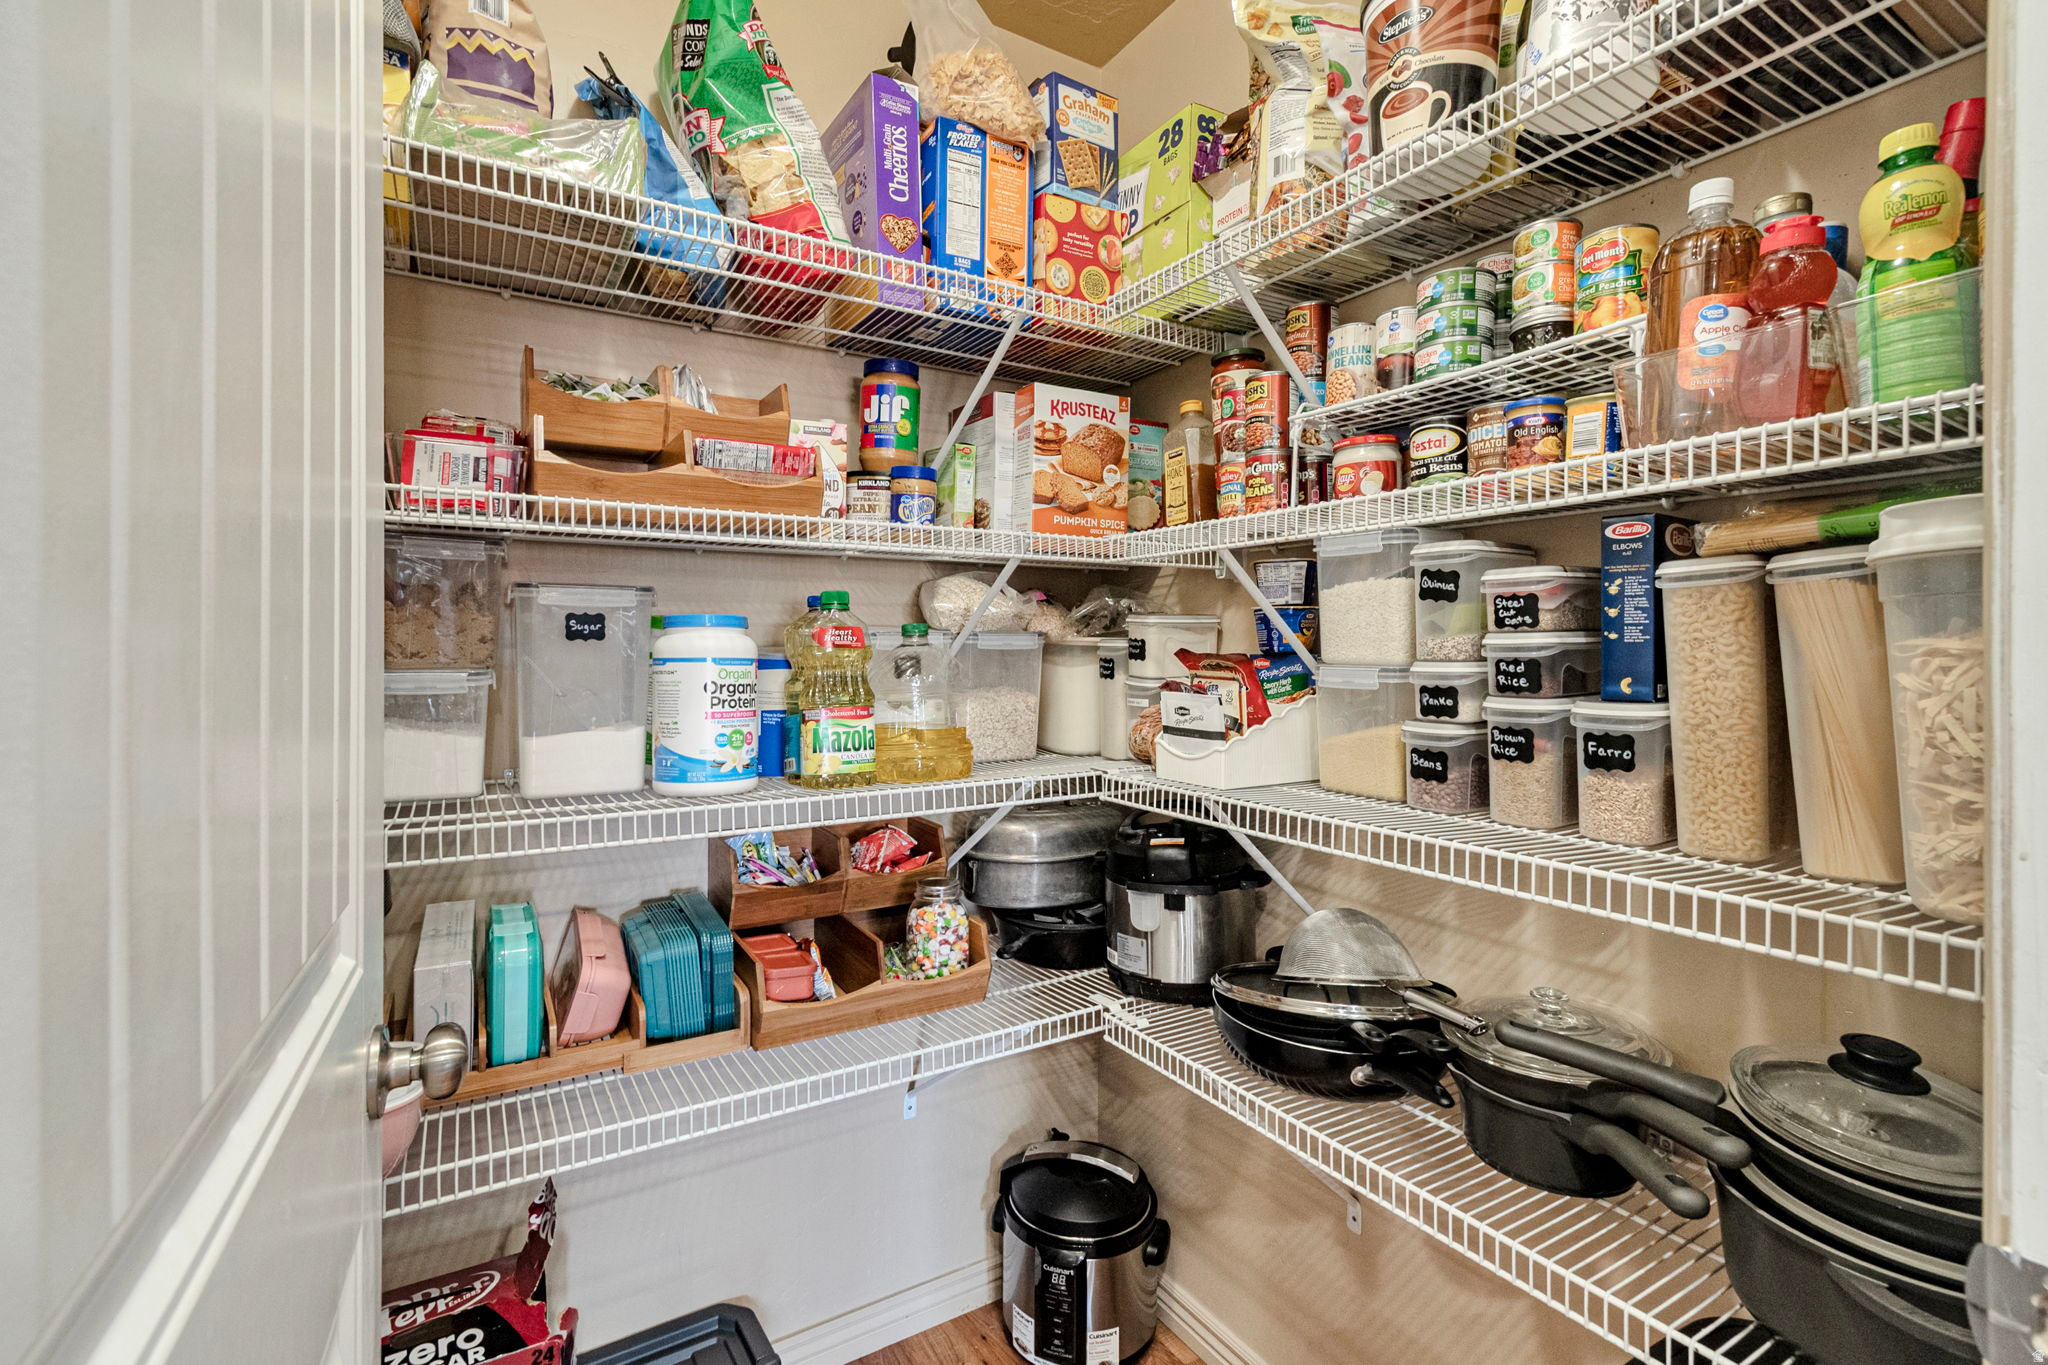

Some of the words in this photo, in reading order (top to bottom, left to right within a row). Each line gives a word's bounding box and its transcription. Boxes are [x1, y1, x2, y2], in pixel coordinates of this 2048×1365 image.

[1382, 10, 1428, 41] Stephen's
[1414, 55, 1445, 66] Chocolate
[1062, 95, 1110, 124] Graham
[882, 124, 892, 145] Grain
[946, 131, 982, 142] FROSTED
[1158, 118, 1184, 159] 28
[948, 138, 978, 149] FLAKES
[883, 148, 892, 170] Multi
[888, 126, 910, 202] Cheerios
[1163, 150, 1178, 166] BAGS
[1216, 206, 1242, 228] PROTEIN
[1906, 212, 1922, 220] LEMON
[1488, 256, 1514, 268] Chicke
[1582, 254, 1594, 267] Del
[1595, 245, 1626, 261] Monte
[1598, 278, 1638, 292] Peaches
[1700, 325, 1730, 334] Apple
[1334, 355, 1372, 368] BEANS
[864, 394, 910, 424] Jif
[1050, 399, 1117, 426] KRUSTEAZ
[1468, 424, 1506, 442] DICE
[1514, 429, 1528, 438] Old
[1530, 425, 1559, 436] English
[1470, 439, 1507, 452] TOMATOE
[450, 456, 460, 482] POPCORN
[460, 454, 470, 486] MICROWAVE
[1166, 466, 1186, 480] HONEY
[1252, 460, 1286, 474] Camp's
[1428, 462, 1463, 473] Beans
[1248, 476, 1266, 488] PORK
[902, 498, 934, 518] CRUNCHY
[1054, 514, 1098, 528] PUMPKIN
[1100, 519, 1126, 530] SPICE
[1614, 524, 1648, 536] Barilla
[1612, 542, 1643, 550] ELBOWS
[1496, 598, 1524, 608] Steel
[569, 620, 602, 634] Sugar
[824, 634, 858, 643] Healthy
[1258, 669, 1278, 680] Recipe
[1278, 664, 1303, 676] Secrets
[1499, 662, 1524, 672] Red
[718, 668, 753, 682] Orgain
[1496, 675, 1530, 687] Rice
[704, 680, 757, 698] Organic
[1263, 680, 1278, 690] Savory
[1279, 678, 1292, 686] Herb
[1267, 687, 1278, 695] with
[1278, 684, 1292, 693] Garlic
[710, 694, 756, 710] Protein
[1422, 692, 1454, 707] Panko
[822, 708, 856, 718] Cholesterol
[856, 707, 869, 716] Free
[1174, 718, 1189, 727] Recipe
[812, 726, 874, 754] Mazola
[1492, 728, 1526, 744] Brown
[1491, 744, 1519, 757] Rice
[1588, 741, 1633, 760] Farro
[1412, 753, 1442, 771] Beans
[1043, 1263, 1074, 1276] Cuisinart
[1088, 1330, 1118, 1340] Cuisinart
[384, 1328, 485, 1365] zero
[532, 1346, 555, 1365] 24
